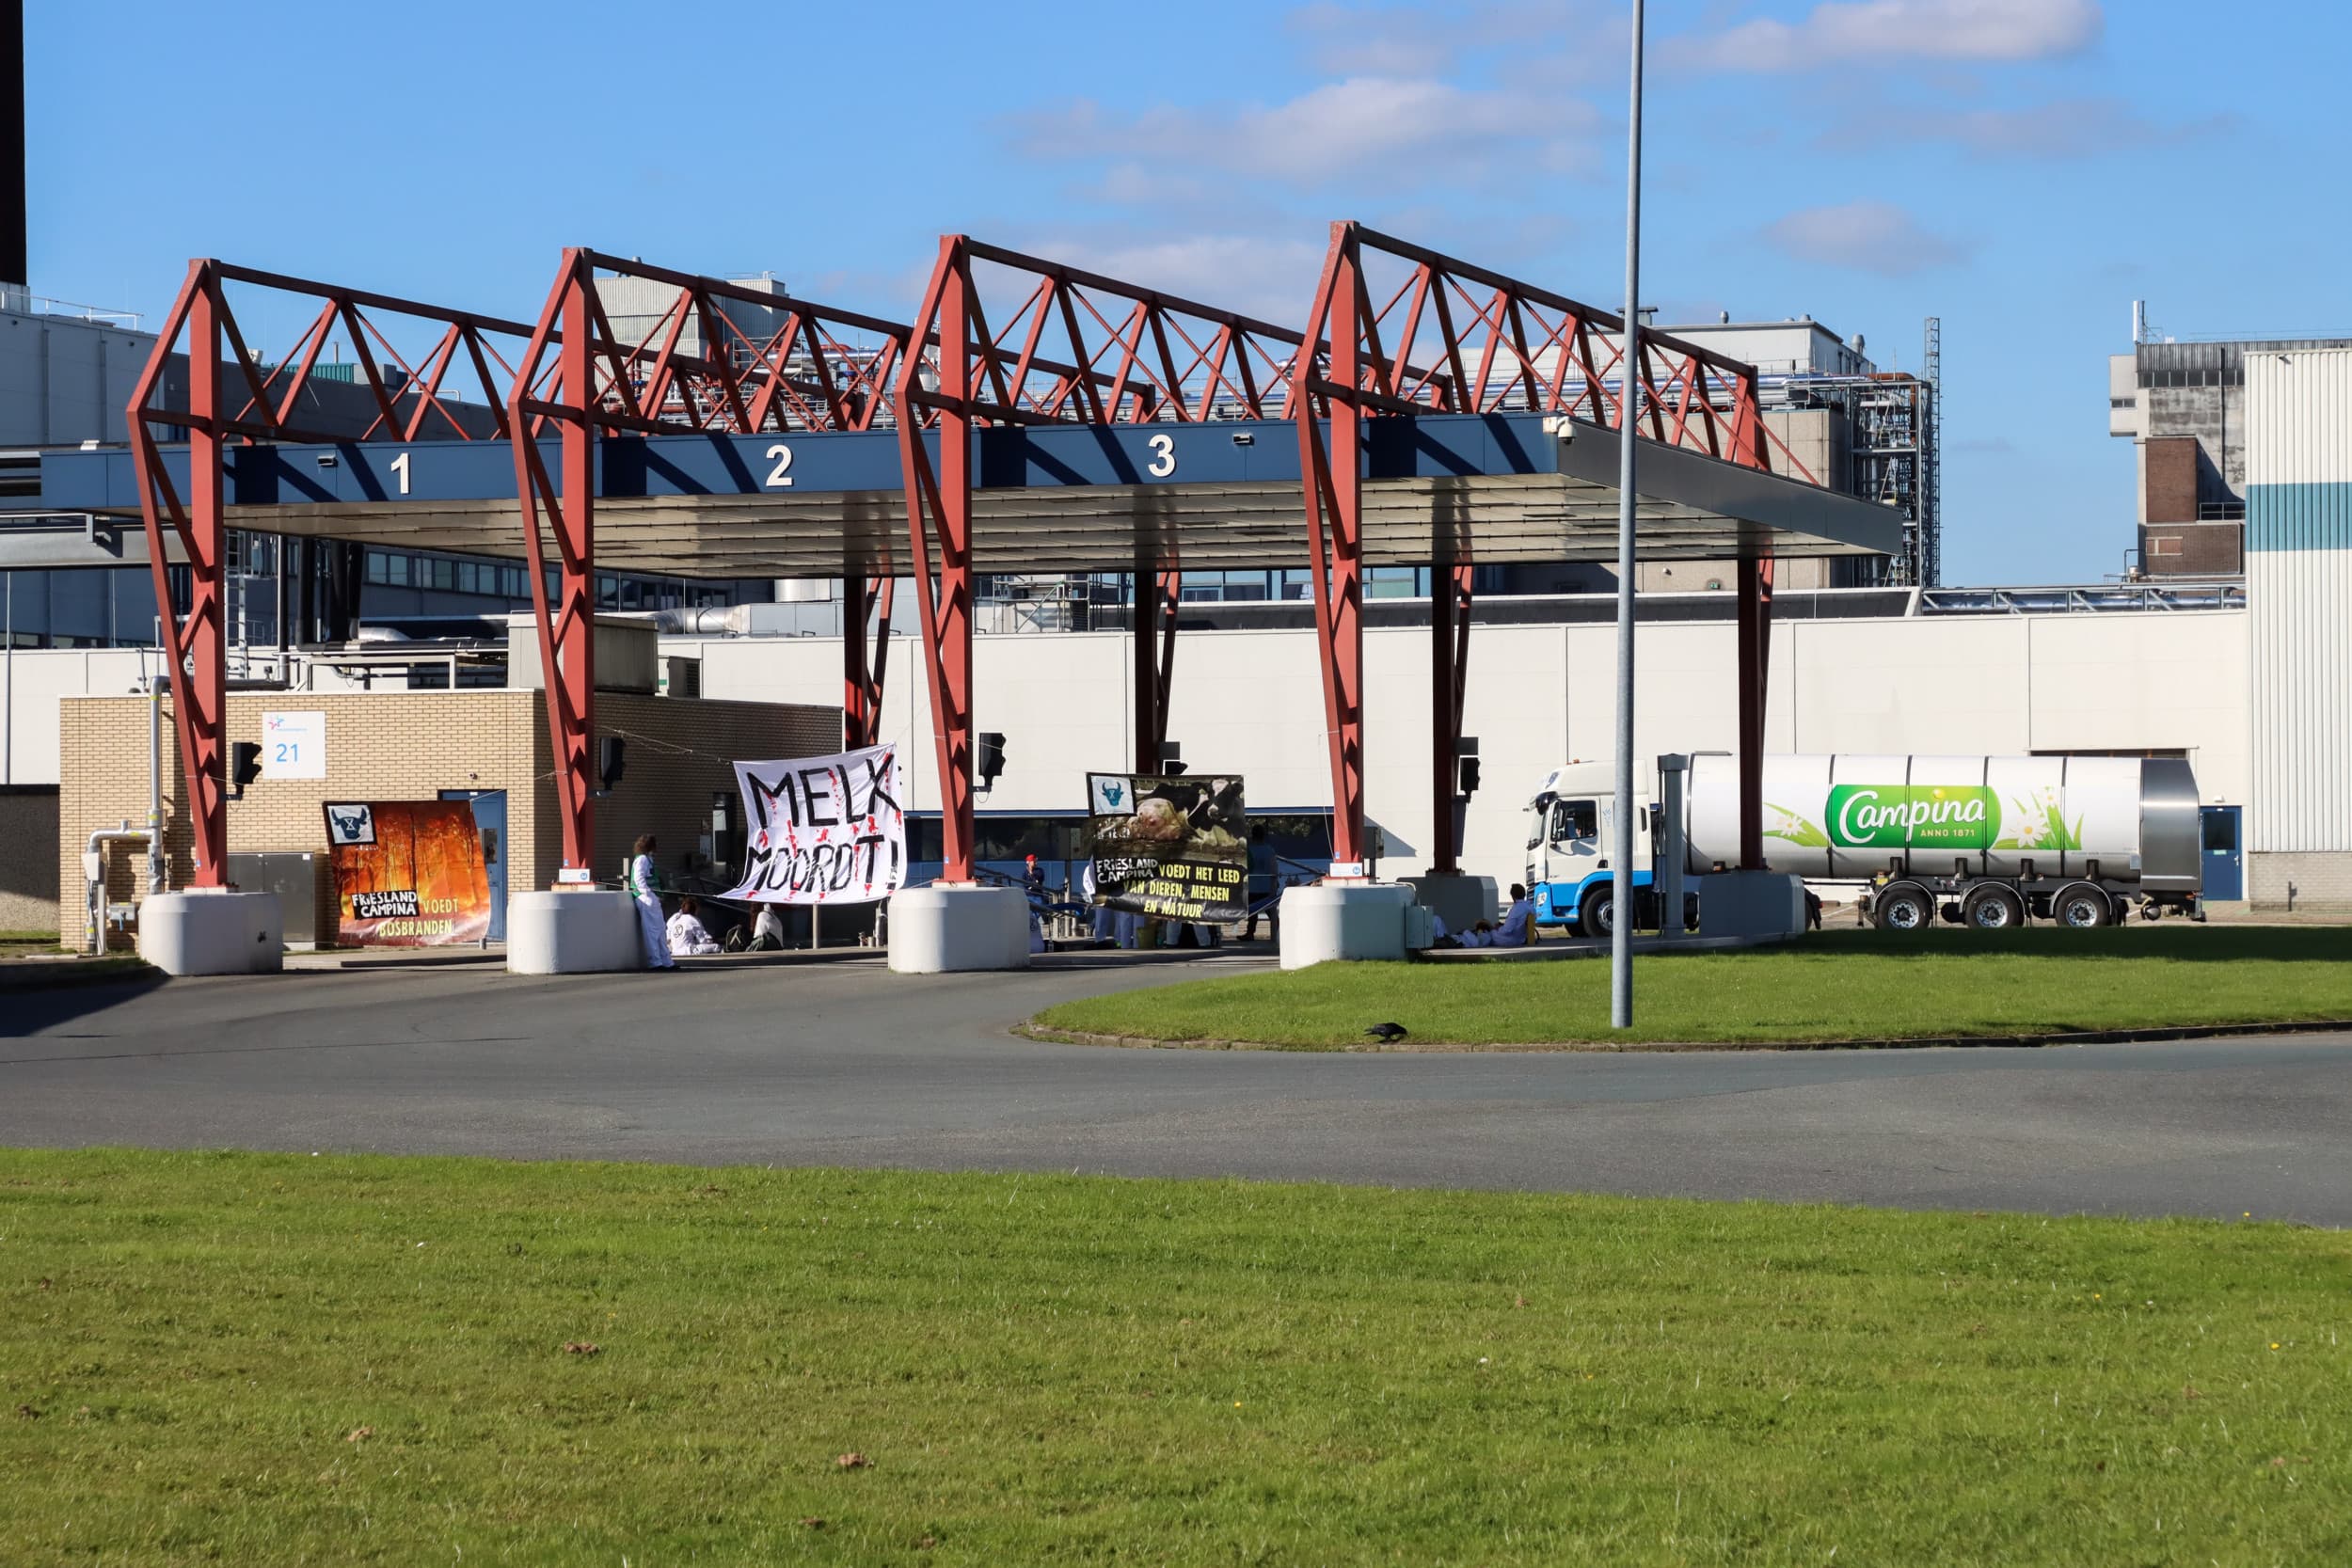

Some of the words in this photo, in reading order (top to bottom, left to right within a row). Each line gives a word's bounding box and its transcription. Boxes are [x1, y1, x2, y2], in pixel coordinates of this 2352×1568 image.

[765, 444, 794, 487] 2
[1147, 434, 1177, 478] 3
[390, 452, 411, 494] 1
[276, 743, 299, 763] 21
[747, 753, 901, 829] MELK
[1839, 789, 1986, 844] Campina
[1920, 829, 1949, 837] ANNO
[1953, 829, 1976, 837] 1871
[1097, 868, 1153, 883] CAMPINA
[1158, 863, 1191, 879] VOEDT
[1196, 865, 1215, 881] HET
[1218, 867, 1241, 883] LEED
[1123, 879, 1145, 895] VAN
[1150, 880, 1185, 899] DIEREN,
[1190, 884, 1230, 902] MENSEN
[360, 902, 417, 918] CAMPINA
[423, 898, 459, 914] VOEDT
[1143, 899, 1158, 913] EN
[1162, 901, 1203, 919] NATUUR
[379, 920, 453, 938] BOSBRANDEN
